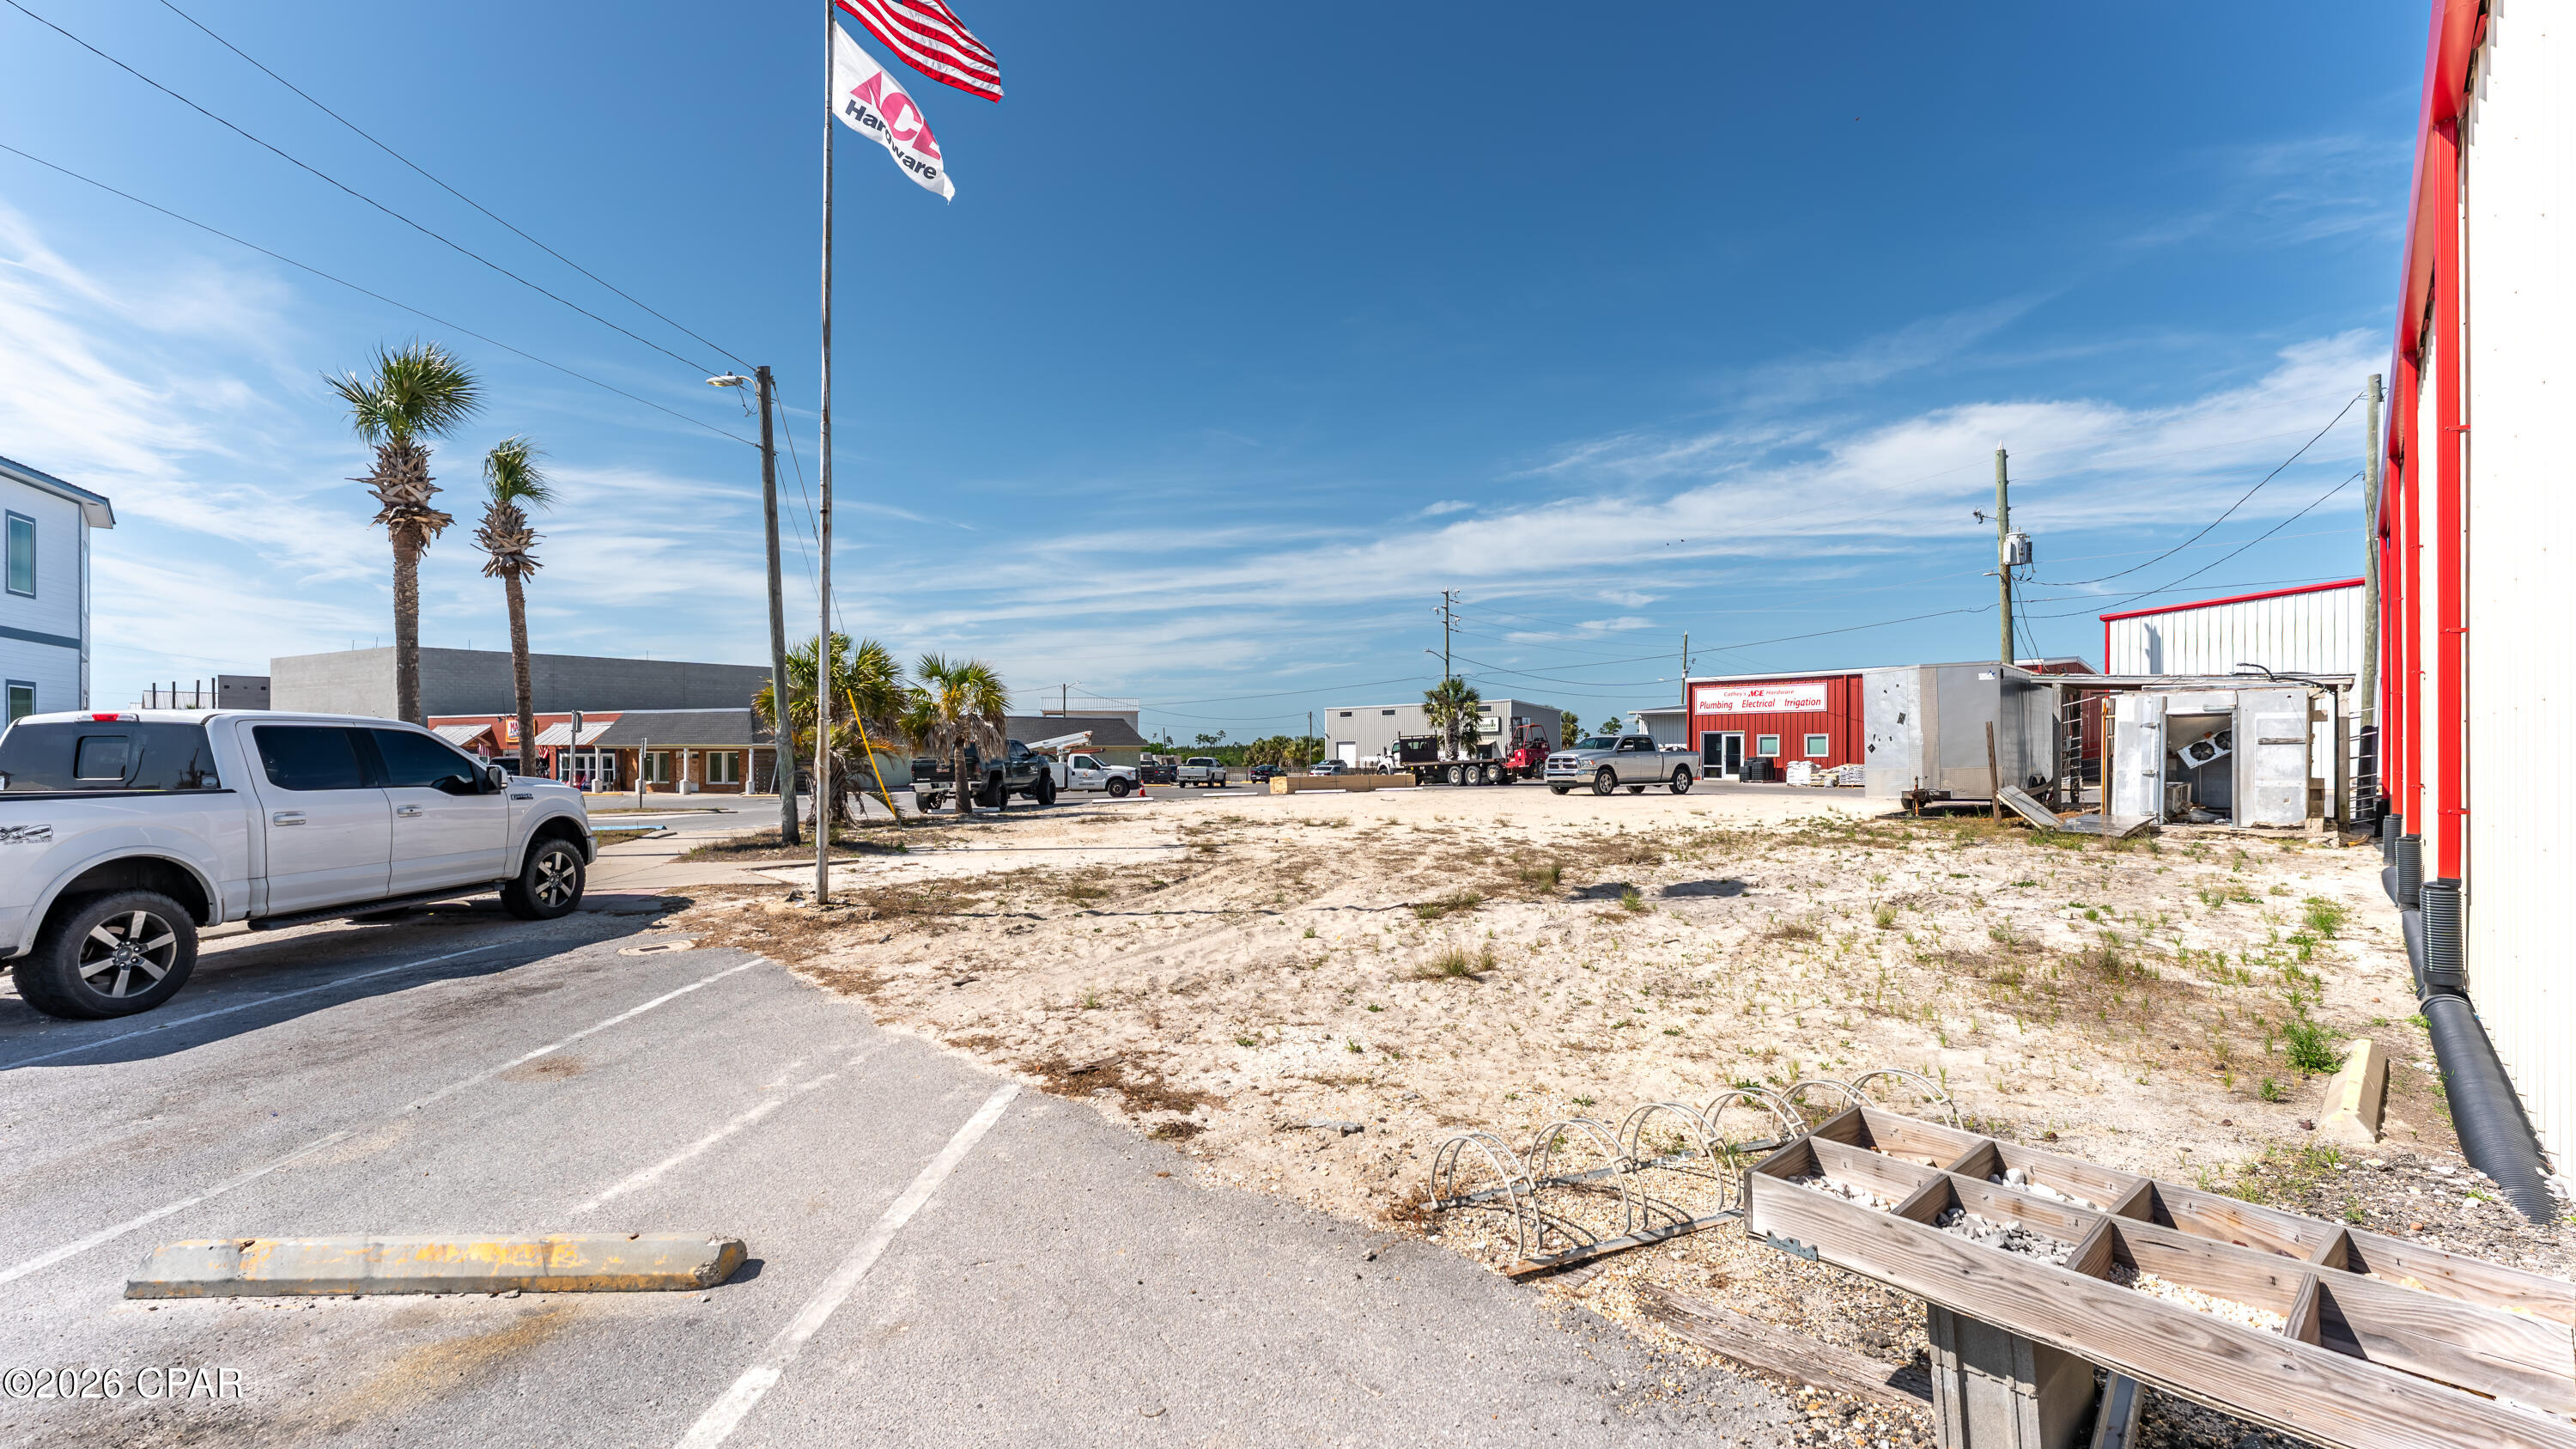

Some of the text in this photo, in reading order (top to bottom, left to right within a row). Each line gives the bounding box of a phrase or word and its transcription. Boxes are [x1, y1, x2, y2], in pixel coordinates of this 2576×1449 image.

[845, 99, 937, 180] Hardware
[1699, 697, 1821, 710] Plumbing Electrical Irrigation
[0, 825, 53, 841] X4
